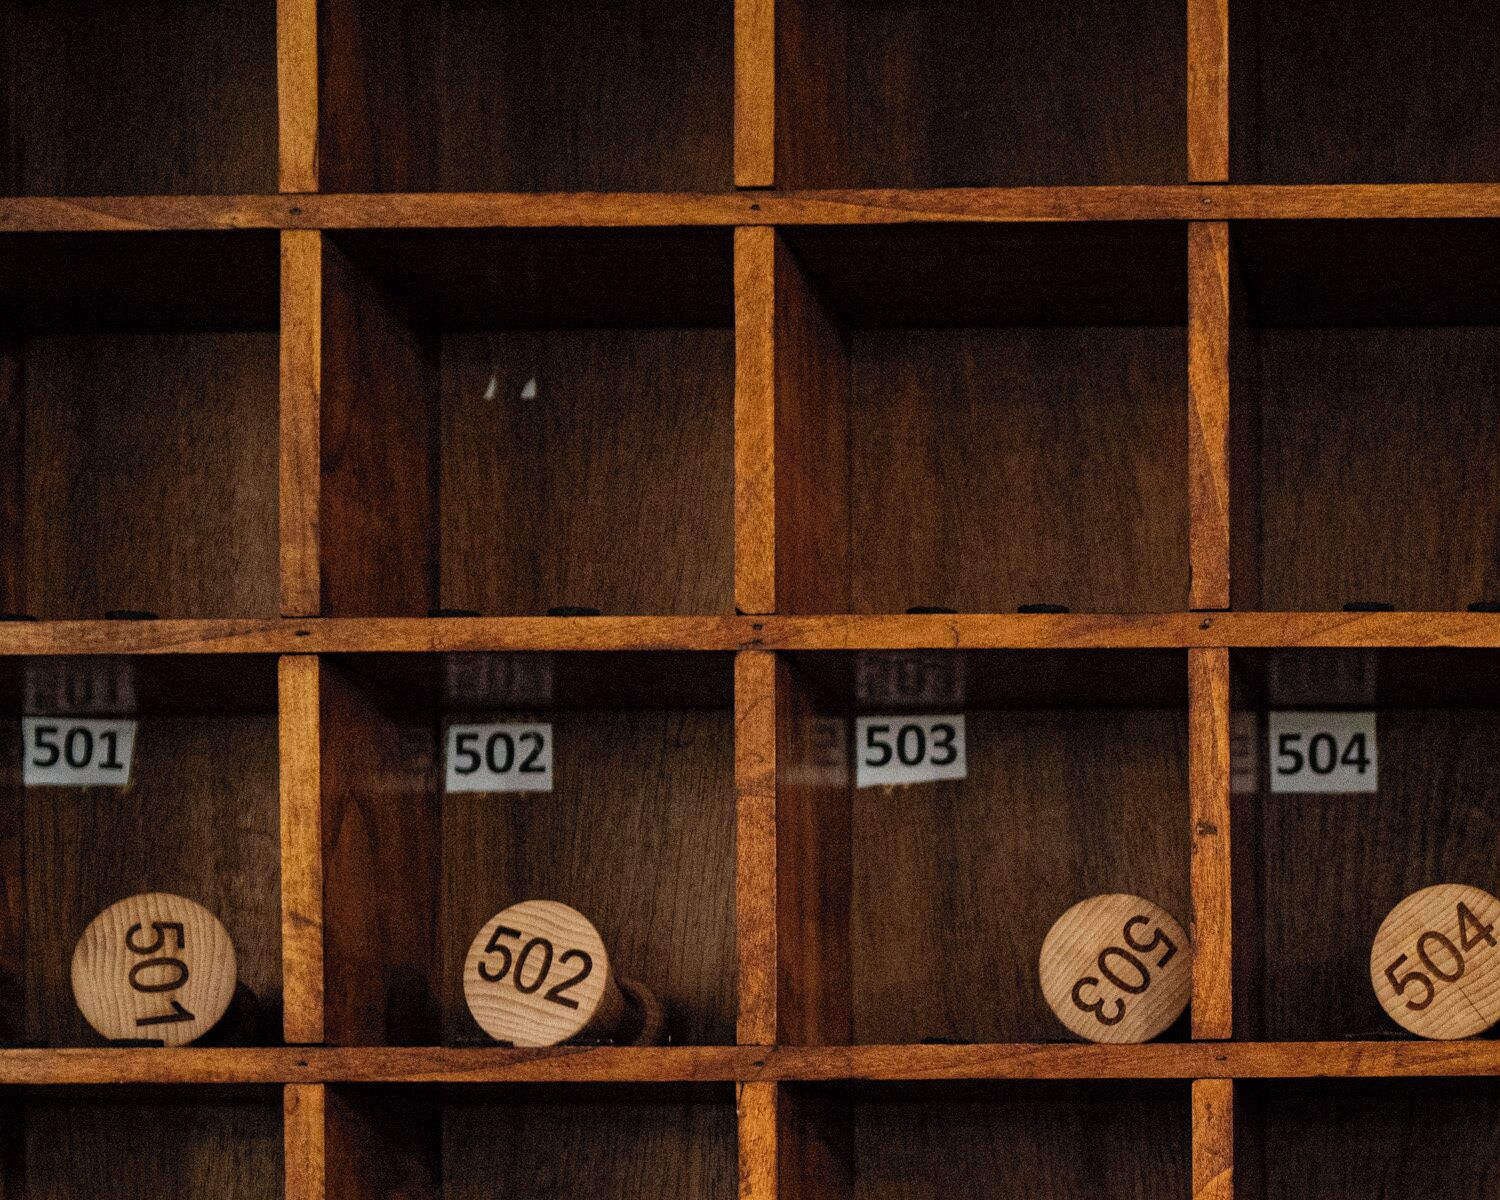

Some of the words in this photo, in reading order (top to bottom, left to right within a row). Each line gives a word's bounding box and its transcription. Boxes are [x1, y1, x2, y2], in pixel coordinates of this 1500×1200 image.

[31, 725, 126, 771] 501
[453, 730, 548, 777] 502
[864, 722, 959, 768] 503
[1276, 731, 1372, 777] 504
[124, 920, 196, 1030] 501
[477, 925, 594, 1009] 502
[1071, 914, 1180, 1027] 503
[1383, 900, 1496, 1013] 504
